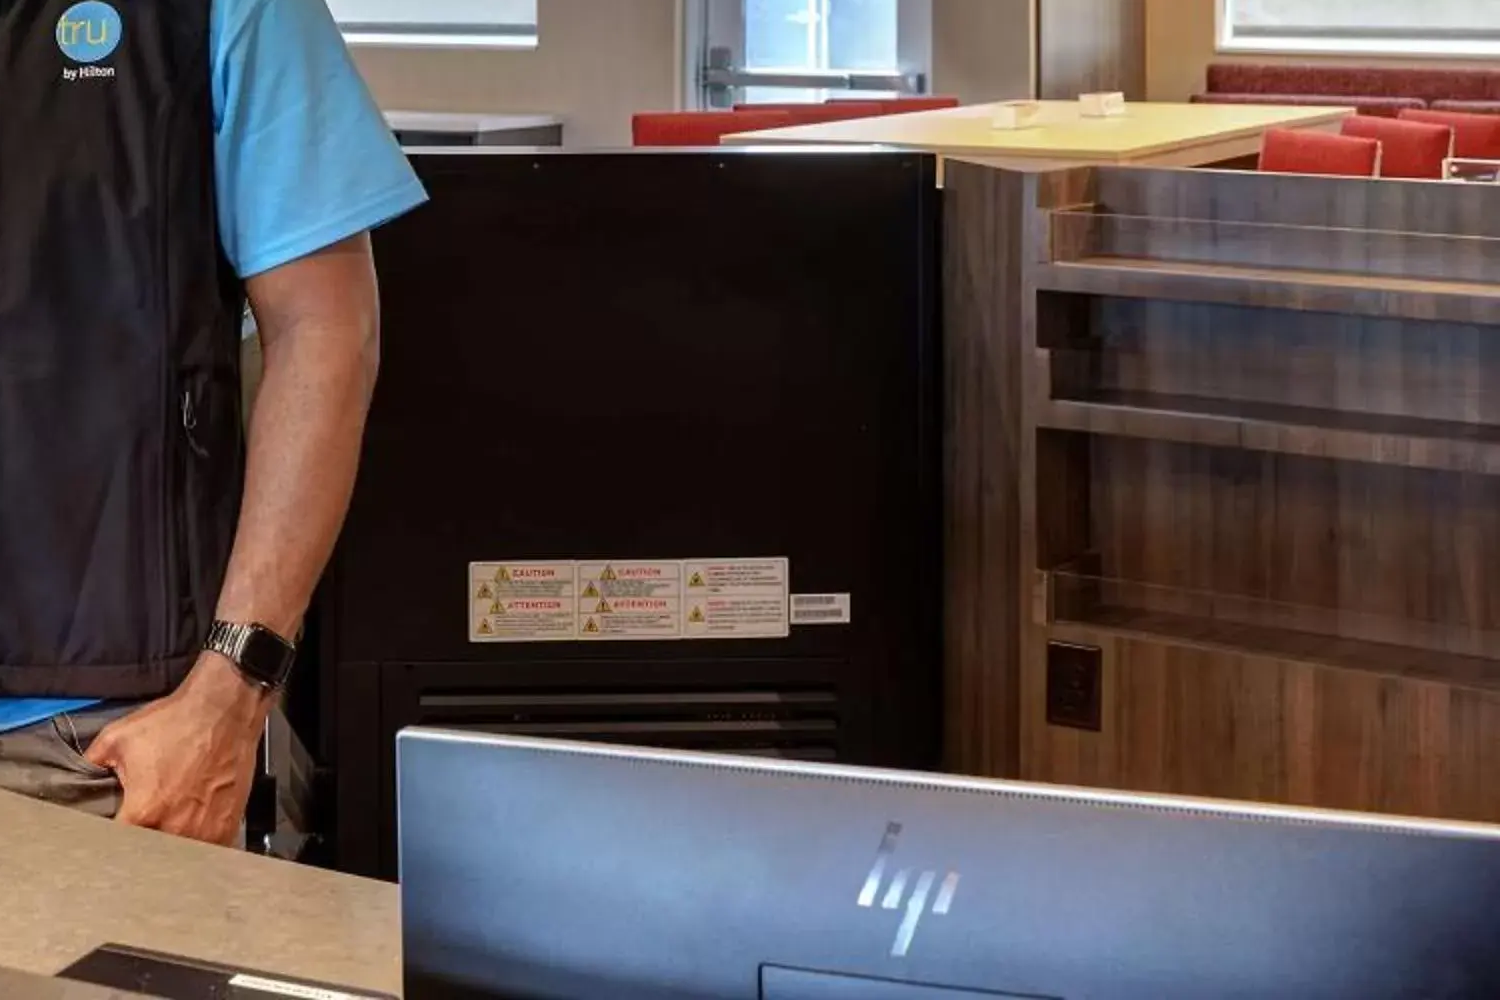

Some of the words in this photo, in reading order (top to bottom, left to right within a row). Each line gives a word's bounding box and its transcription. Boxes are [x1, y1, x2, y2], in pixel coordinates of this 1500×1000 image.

[59, 15, 107, 46] tru
[63, 67, 77, 81] by
[79, 66, 115, 78] Hilton
